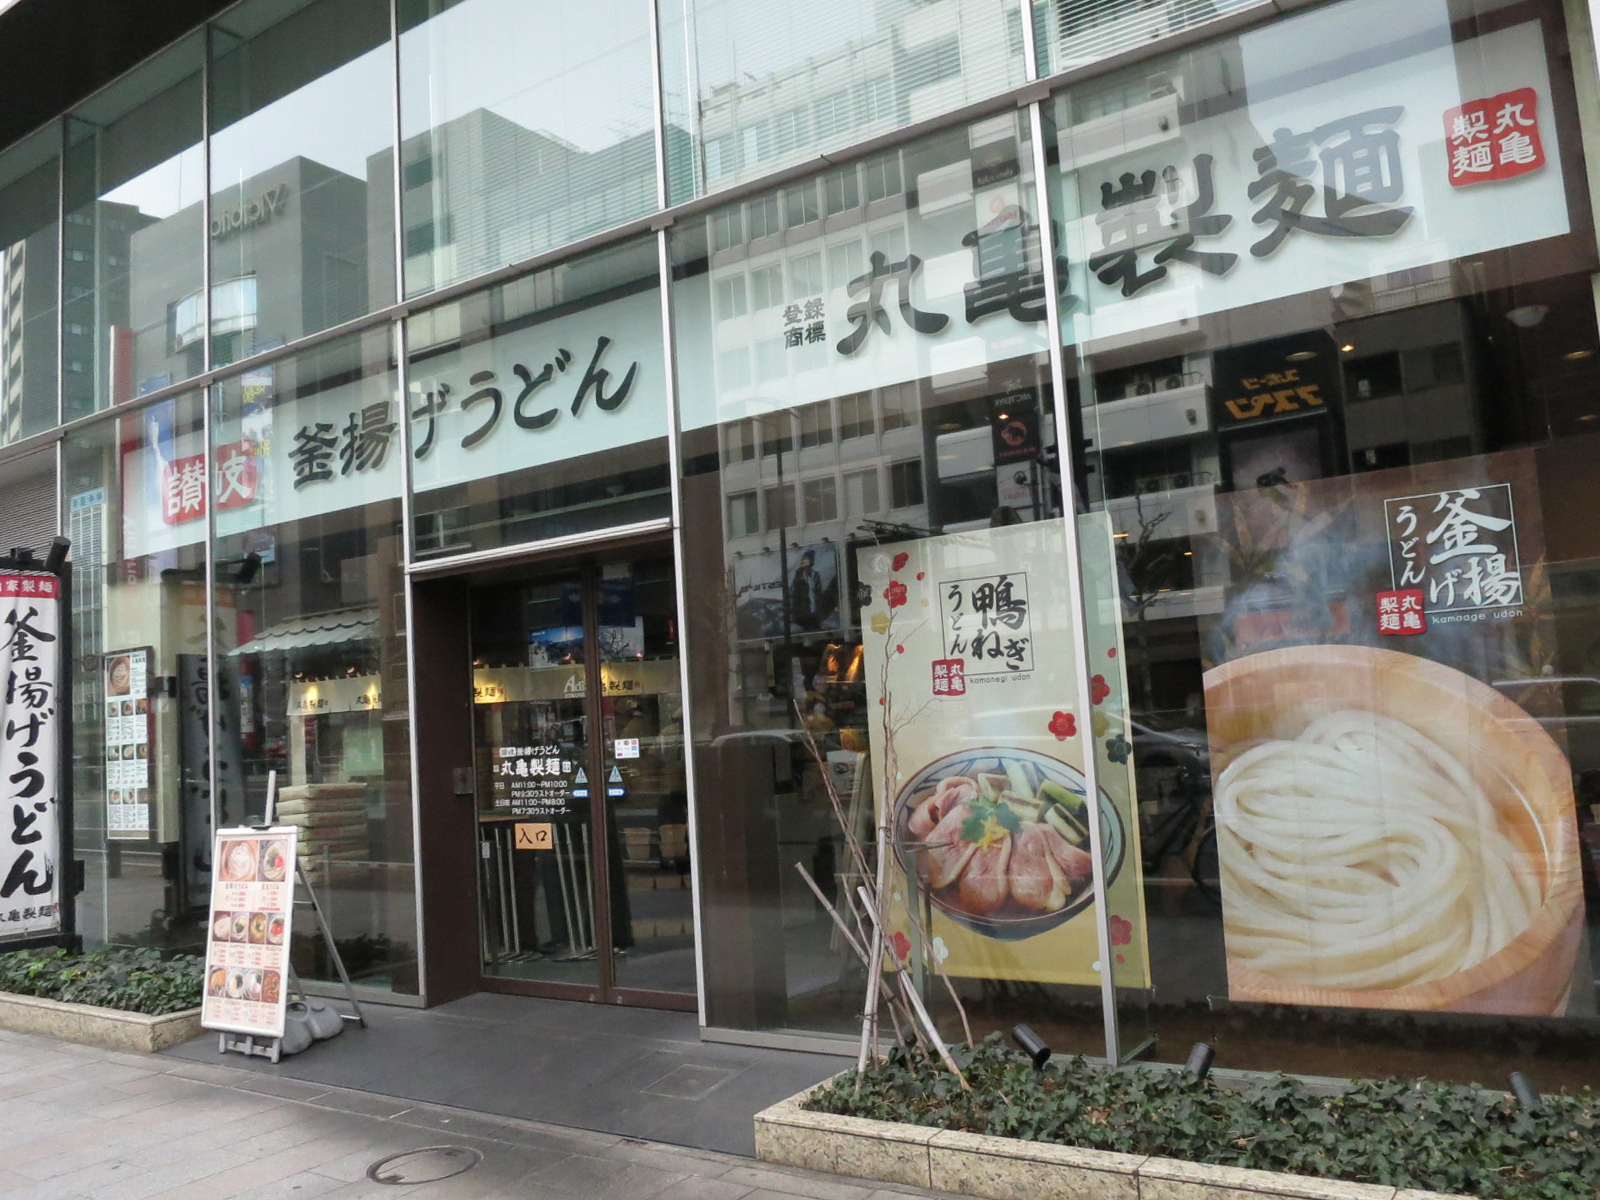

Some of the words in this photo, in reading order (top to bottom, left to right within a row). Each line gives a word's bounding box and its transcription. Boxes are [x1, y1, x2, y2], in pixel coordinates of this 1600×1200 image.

[1451, 113, 1493, 178] 製麺
[1493, 102, 1539, 165] 丸亀
[836, 106, 1415, 356] 丸亀製麺
[782, 299, 825, 325] 登録
[784, 321, 826, 350] 商標
[288, 336, 637, 491] 釜揚げうどん
[1396, 505, 1426, 586] うどん
[0, 579, 53, 593] 家製麺
[948, 584, 968, 656] うどん
[1379, 597, 1401, 630] 製麺
[1401, 595, 1422, 629] 丸亀
[1432, 612, 1486, 624] kamaage
[1493, 609, 1523, 619] udon
[1, 605, 56, 898] 釜揚げうどん
[500, 758, 561, 777] 丸亀製麺
[519, 829, 548, 844] 入口
